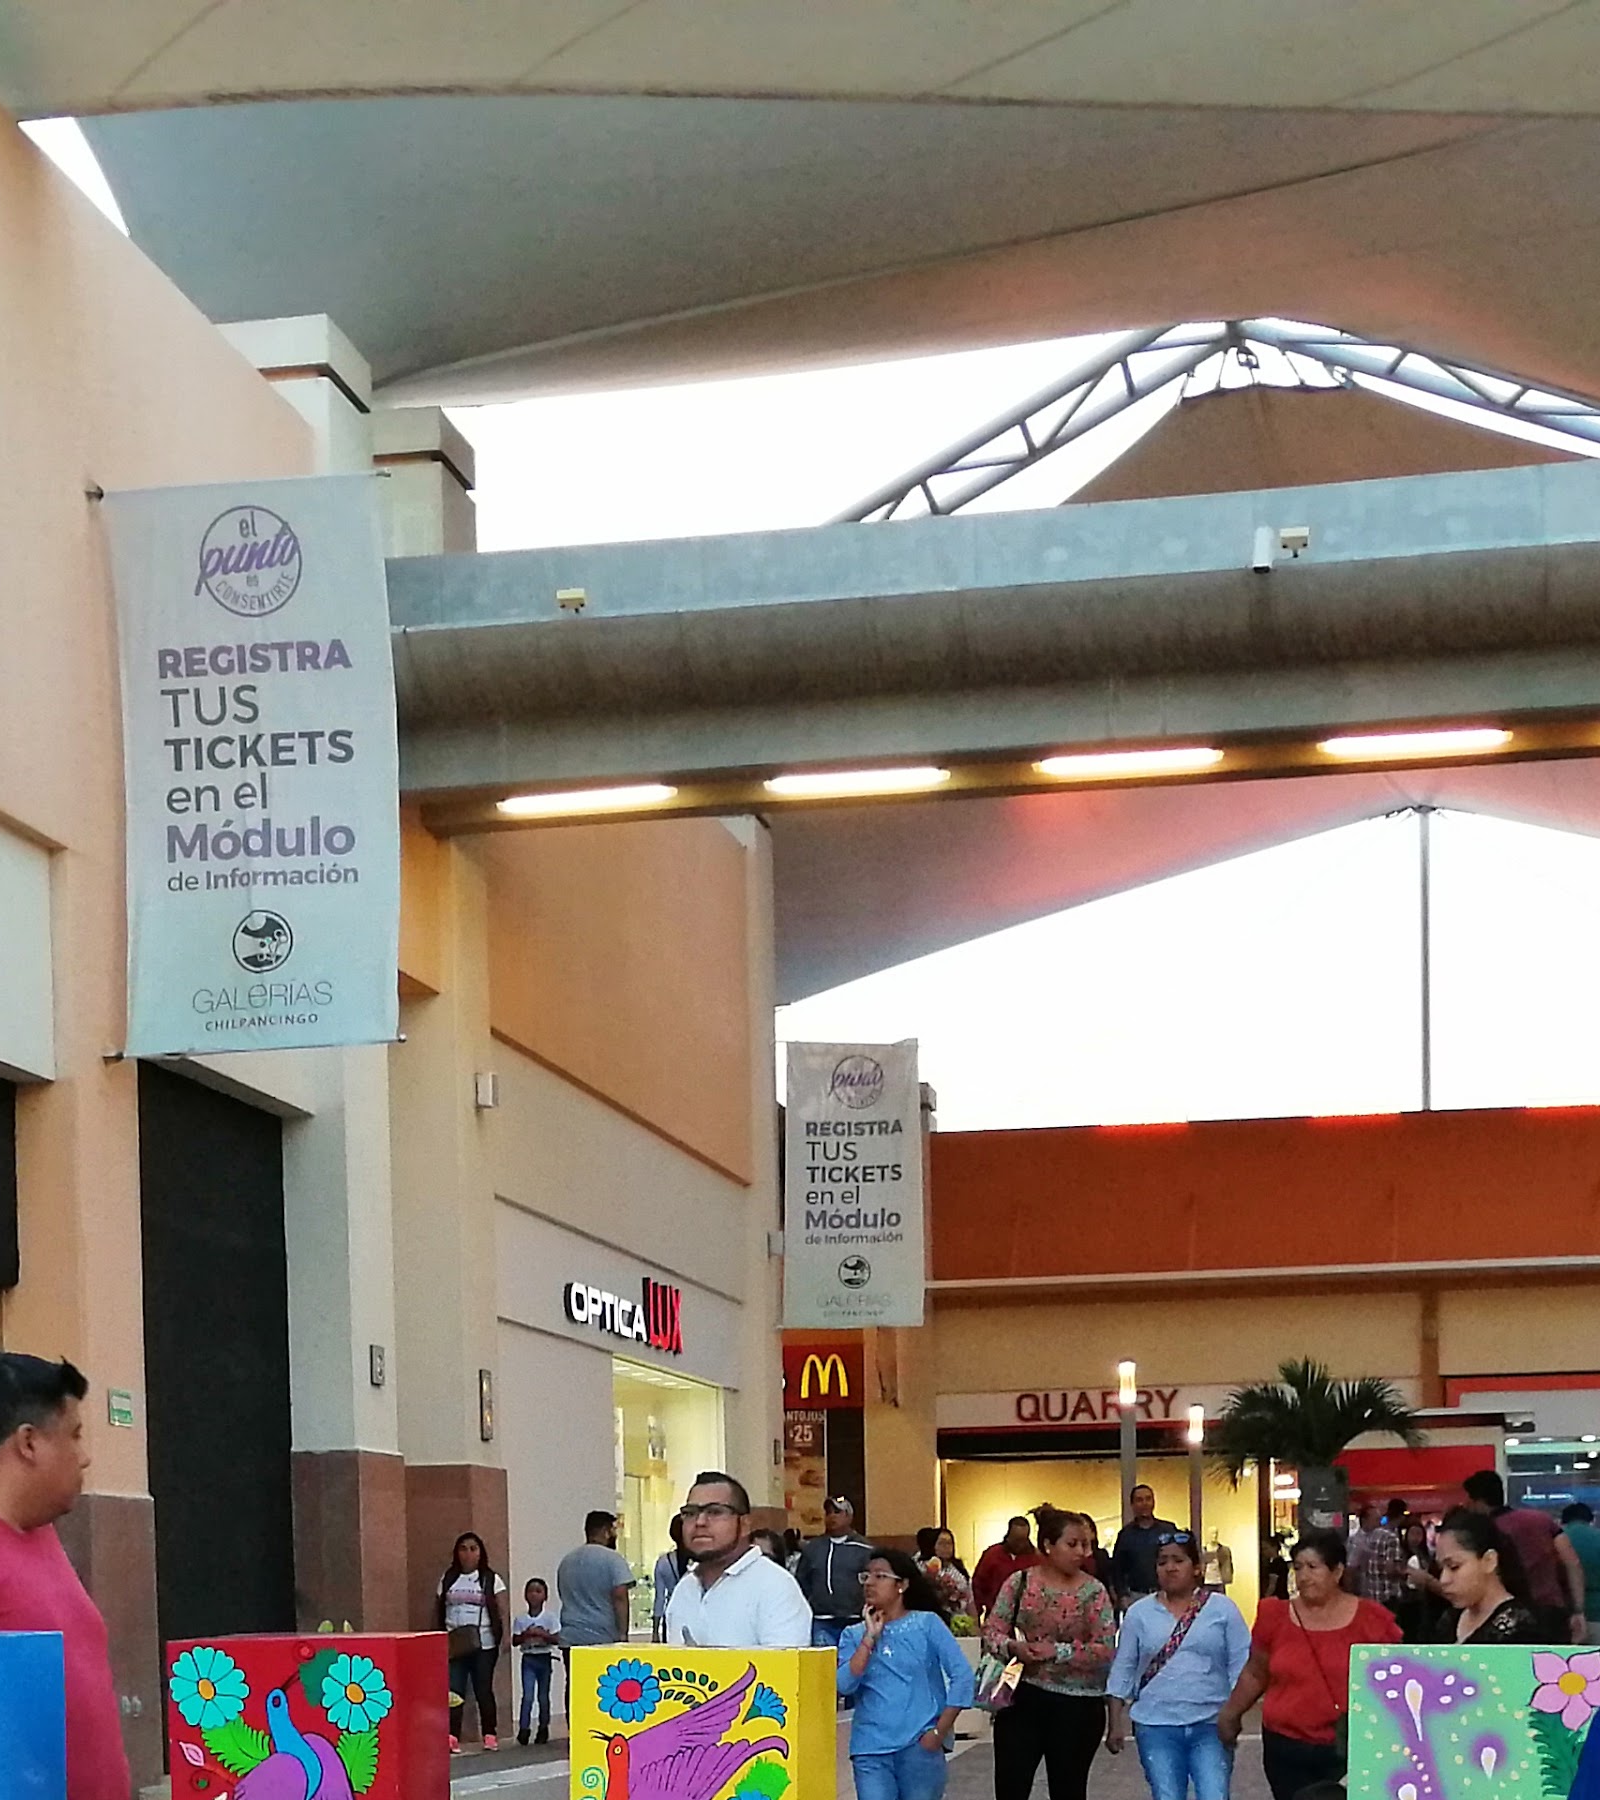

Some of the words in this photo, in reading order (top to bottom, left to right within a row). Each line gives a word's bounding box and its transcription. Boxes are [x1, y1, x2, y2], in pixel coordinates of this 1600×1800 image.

[239, 511, 257, 538] el
[194, 522, 298, 596] punto
[215, 572, 295, 610] CONSENTIRTE
[158, 639, 352, 679] REGISTRA
[160, 684, 259, 727] TUS
[164, 730, 354, 771] TICKETS
[166, 785, 220, 814] en
[233, 772, 267, 810] el
[167, 816, 355, 863] Módulo
[168, 872, 199, 891] de
[206, 863, 359, 890] Información
[205, 1013, 319, 1031] CHILPANCINGO
[806, 1119, 903, 1137] REGISTRA
[806, 1141, 858, 1161] TUS
[806, 1164, 903, 1184] TICKETS
[806, 1189, 834, 1205] en
[841, 1186, 860, 1204] el
[806, 1208, 901, 1230] Módulo
[806, 1234, 822, 1245] de
[825, 1232, 903, 1245] Información
[566, 1281, 648, 1344] OPTICA
[645, 1278, 683, 1354] LUX
[1016, 1389, 1178, 1422] QUARRY
